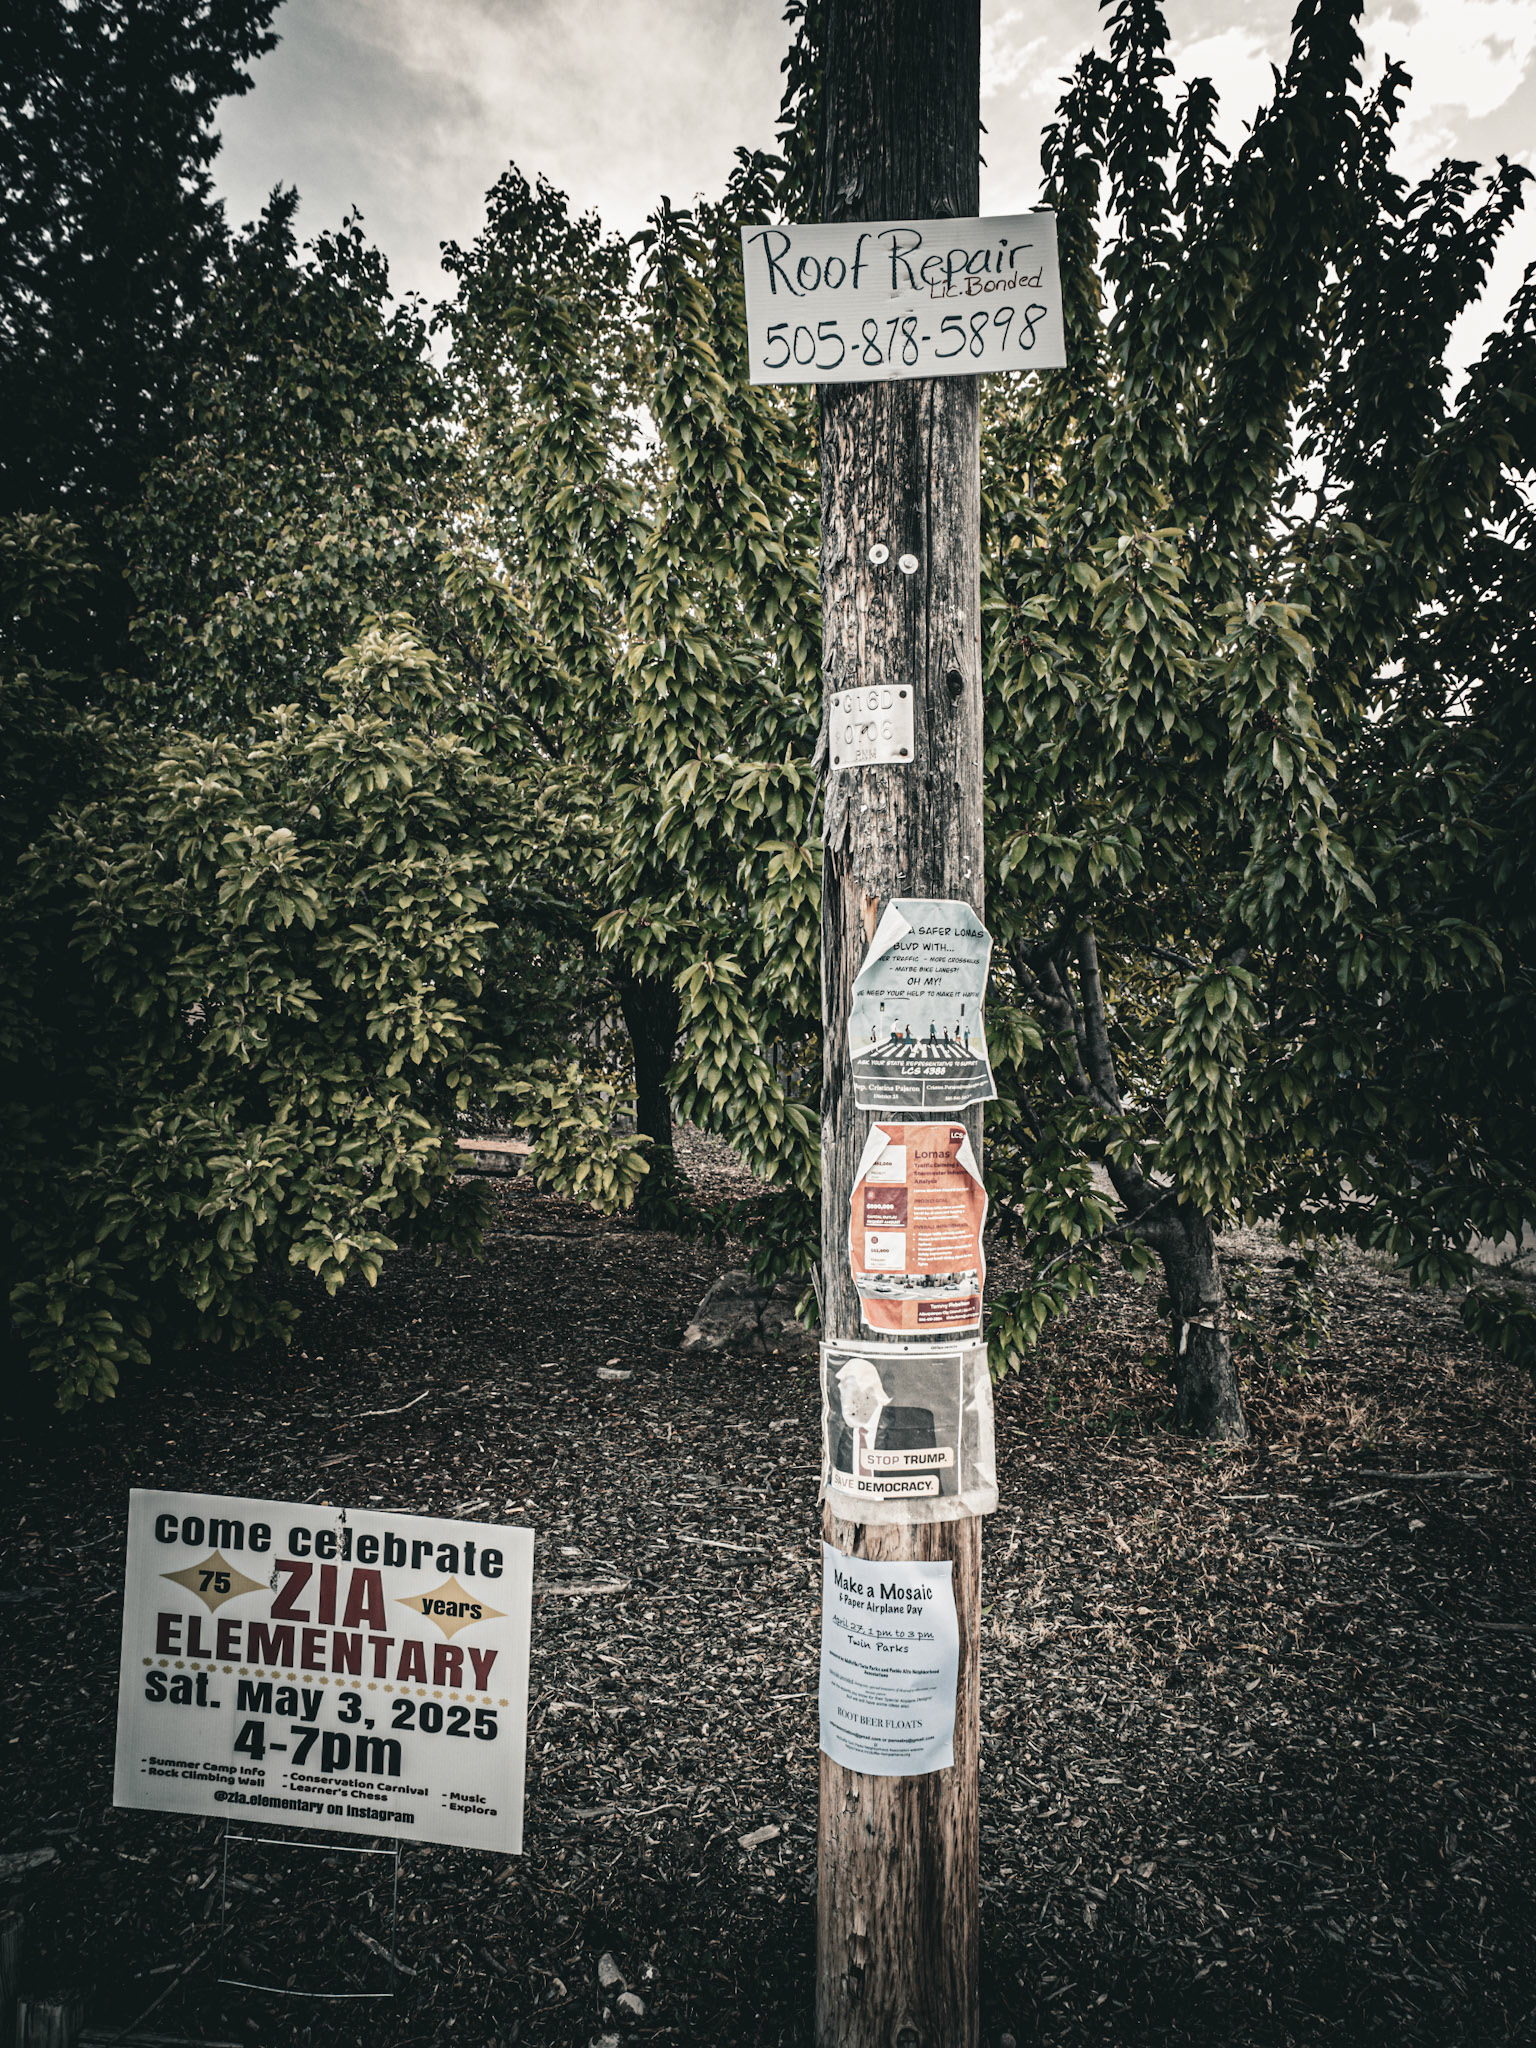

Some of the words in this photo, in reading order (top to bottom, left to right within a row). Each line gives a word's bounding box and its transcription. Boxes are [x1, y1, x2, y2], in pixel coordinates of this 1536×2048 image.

[748, 230, 871, 297] Roof
[878, 228, 1033, 291] Repair
[964, 267, 1043, 296] Bonded
[763, 303, 1048, 370] 505-878-5898
[918, 926, 951, 936] SAFER
[954, 928, 984, 939] LOMAS
[893, 942, 919, 952] BLVD
[922, 943, 955, 952] WITH...
[907, 977, 921, 986] OH
[923, 977, 942, 986] MY!
[901, 1066, 921, 1075] LCS
[914, 1150, 950, 1159] Lomas
[867, 1454, 900, 1466] STOP
[904, 1452, 948, 1465] TRUMP.
[834, 1474, 855, 1489] SAVE
[857, 1480, 934, 1493] DEMOCRACY.
[154, 1514, 272, 1553] come
[288, 1527, 504, 1578] celebrate
[198, 1570, 231, 1594] 75
[834, 1568, 864, 1596] Make
[867, 1586, 875, 1599] a
[880, 1583, 933, 1601] Mosaic
[270, 1559, 388, 1631] ZIA
[844, 1594, 865, 1609] Paper
[866, 1601, 904, 1615] Airplane
[907, 1604, 923, 1616] Day
[420, 1597, 482, 1620] years
[832, 1614, 848, 1628] April
[876, 1629, 893, 1639] pm
[895, 1630, 905, 1638] to
[907, 1630, 915, 1638] 3
[918, 1631, 935, 1641] pm
[155, 1612, 498, 1691] ELEMENTARY
[847, 1635, 871, 1650] Twin
[876, 1641, 909, 1654] Parks
[144, 1670, 221, 1709] Sat.
[236, 1679, 324, 1722] May
[338, 1691, 375, 1730] 3,
[391, 1698, 498, 1741] 2025
[837, 1706, 859, 1723] ROOT
[860, 1715, 884, 1728] BEER
[885, 1719, 923, 1729] FLOATS
[233, 1719, 402, 1777] 4-7pm
[148, 1756, 200, 1770] Summer
[203, 1762, 237, 1775] Camp
[240, 1766, 266, 1777] Info
[148, 1767, 179, 1778] Rock
[181, 1770, 235, 1785] Climbing
[238, 1776, 265, 1787] Wall
[290, 1772, 374, 1789] Conservation
[377, 1782, 429, 1796] Carnival
[290, 1782, 348, 1797] Learner's
[351, 1790, 388, 1802] Chess
[214, 1790, 324, 1815] @zia.elementary
[327, 1803, 343, 1816] on
[347, 1804, 415, 1824] Instagram
[449, 1802, 498, 1816] Explora
[450, 1792, 487, 1804] Music
